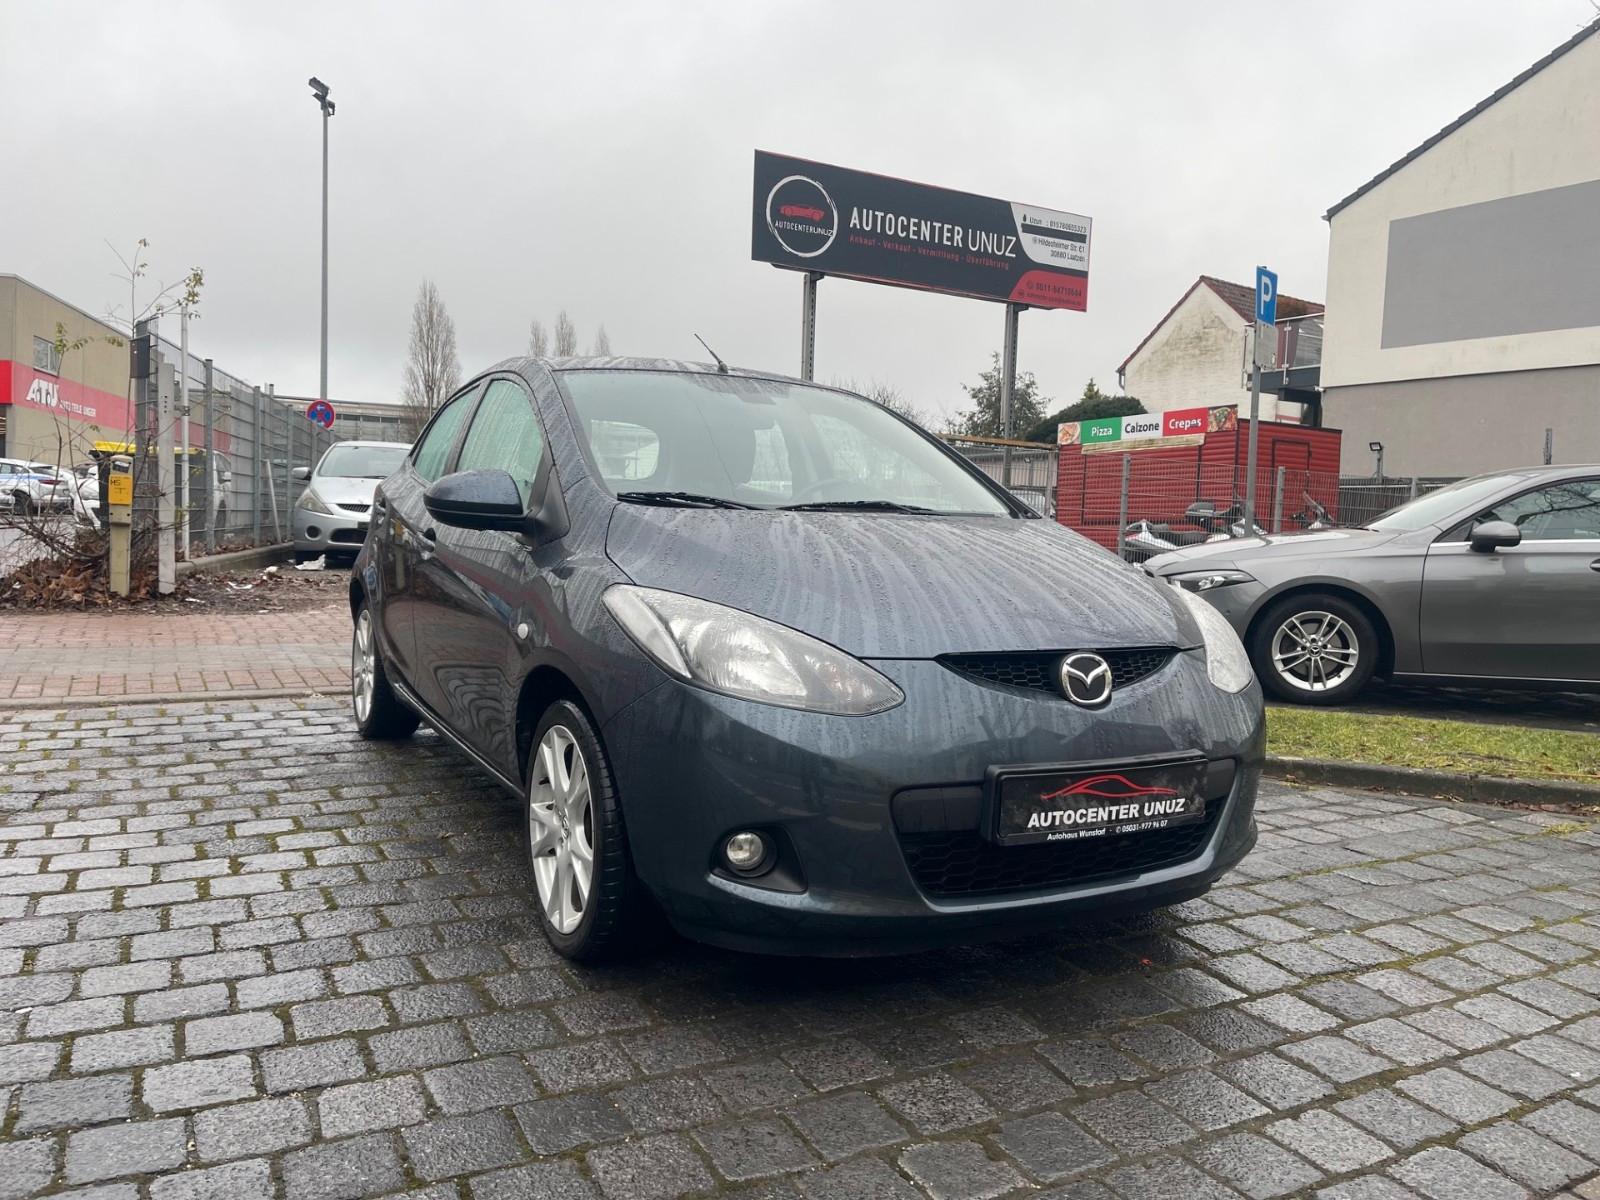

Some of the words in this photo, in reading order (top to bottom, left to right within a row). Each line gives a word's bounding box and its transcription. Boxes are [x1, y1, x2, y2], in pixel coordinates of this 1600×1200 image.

[850, 207, 963, 248] AUTOCENTER
[968, 229, 1017, 258] UNUZ
[1261, 275, 1272, 315] P
[26, 378, 59, 408] ATU
[1091, 425, 1113, 437] Pizza
[1124, 421, 1160, 434] Calzone
[1169, 418, 1202, 430] Crepes
[1027, 803, 1140, 829] AUTOCENTER
[1143, 797, 1186, 817] UNUZ
[1046, 831, 1078, 841] Autohaus
[1079, 828, 1106, 839] Wunstorf
